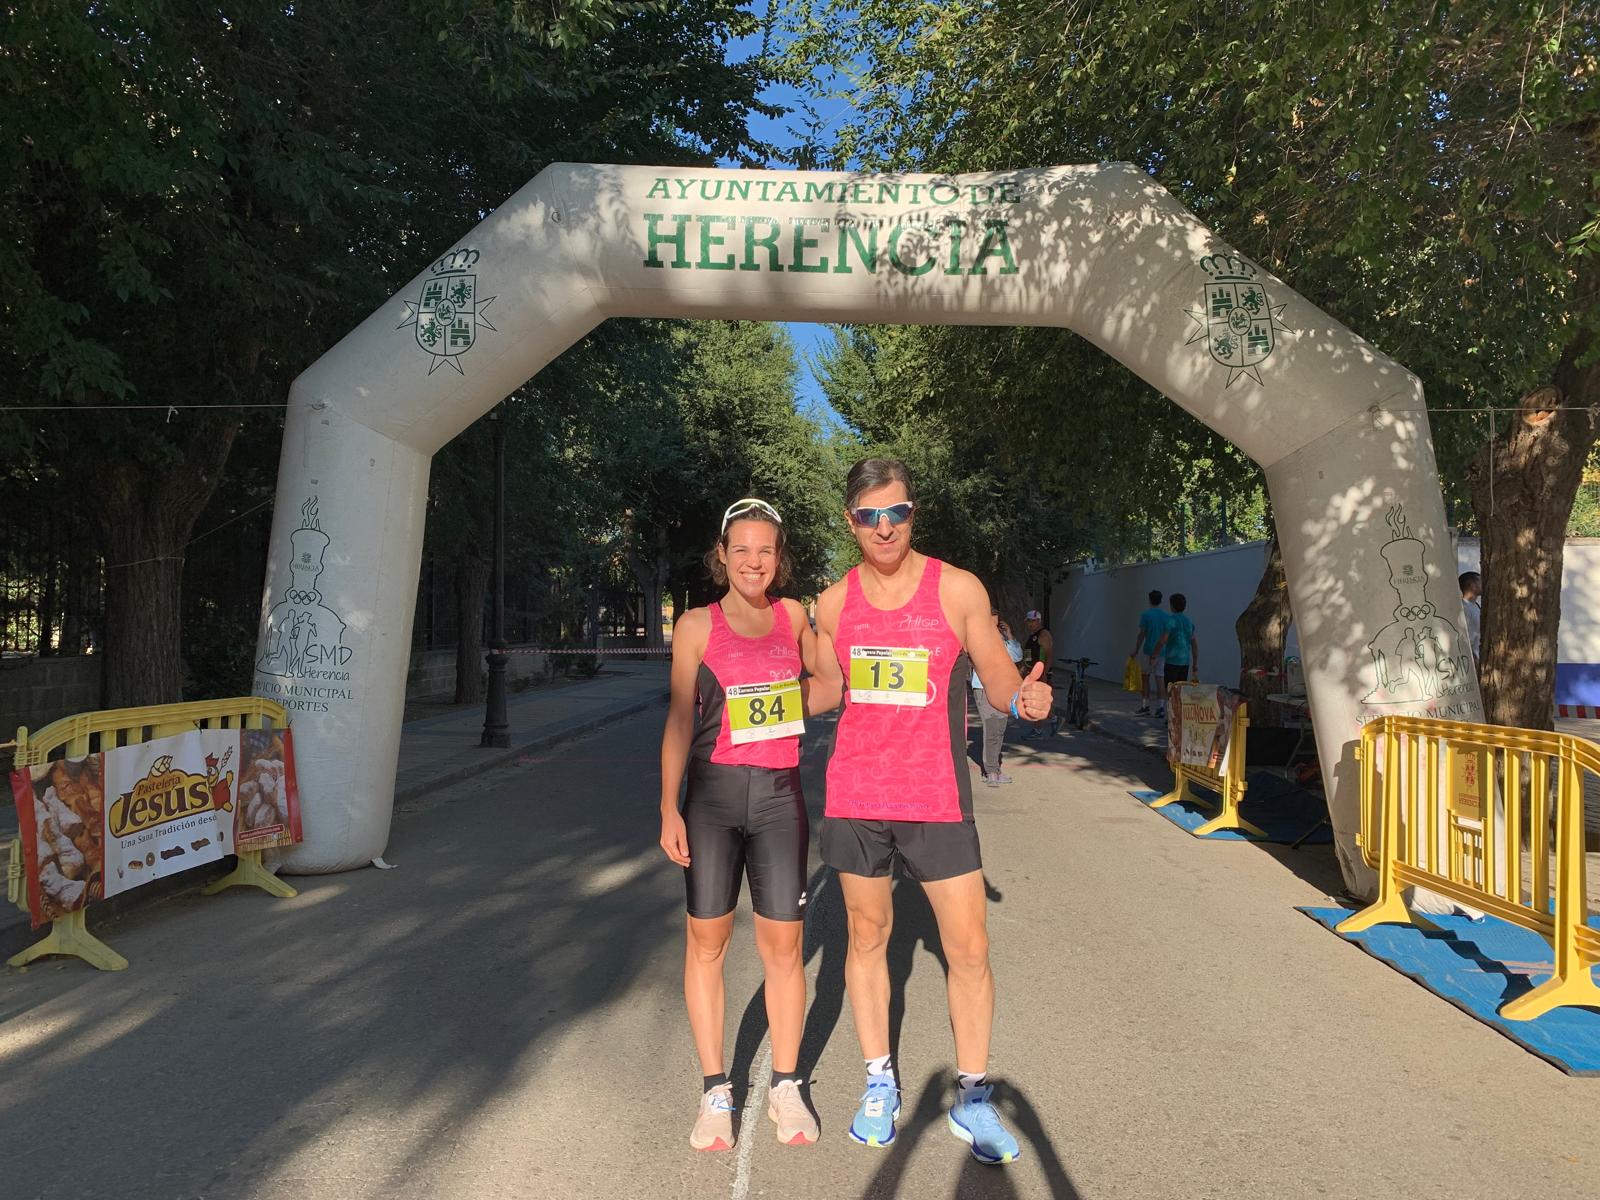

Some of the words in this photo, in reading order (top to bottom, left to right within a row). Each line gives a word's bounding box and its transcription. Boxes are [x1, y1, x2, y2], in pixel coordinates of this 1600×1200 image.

[646, 177, 961, 206] AYUNTAMIENTO
[969, 182, 1021, 204] DE
[642, 213, 1020, 276] HERENCIA
[305, 643, 353, 666] SMD
[304, 666, 350, 681] Herencia
[870, 661, 905, 689] 13
[1437, 655, 1470, 681] SMD
[284, 685, 353, 700] MUNICIPAL
[728, 687, 738, 696] 48
[271, 698, 329, 712] PORTES
[749, 695, 785, 725] 84
[1426, 701, 1480, 718] MUNICIPAL
[121, 840, 136, 849] Una
[155, 820, 196, 839] Tradición
